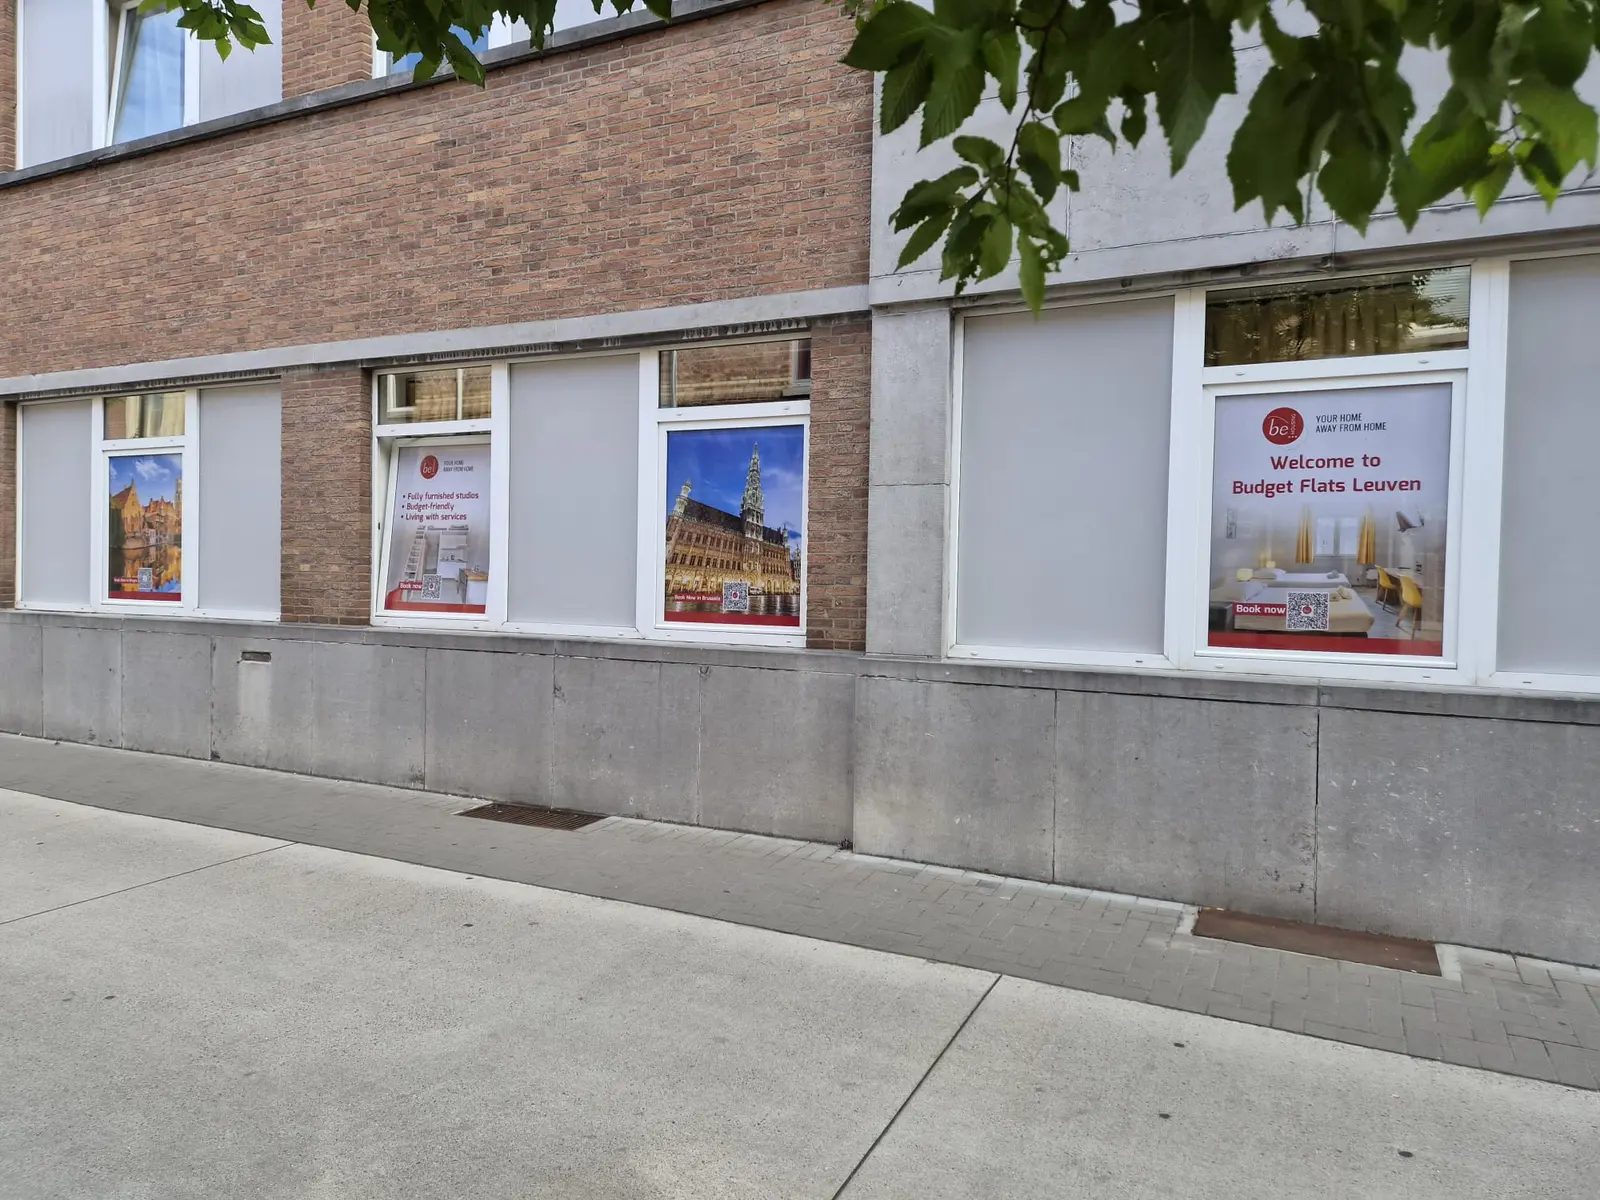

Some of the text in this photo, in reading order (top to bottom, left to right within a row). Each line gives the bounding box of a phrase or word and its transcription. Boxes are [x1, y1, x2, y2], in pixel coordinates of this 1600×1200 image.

[1316, 413, 1362, 423] YOUR HOME
[1269, 418, 1288, 436] be
[1315, 422, 1386, 433] AWAY FROM HOME
[1270, 454, 1381, 470] Welcome to
[1232, 477, 1421, 498] Budget Flats Leuven
[407, 491, 479, 501] Fully furnished studios
[406, 502, 454, 512] Budget-friendly
[405, 513, 423, 522] Living
[1236, 604, 1286, 614] Book now
